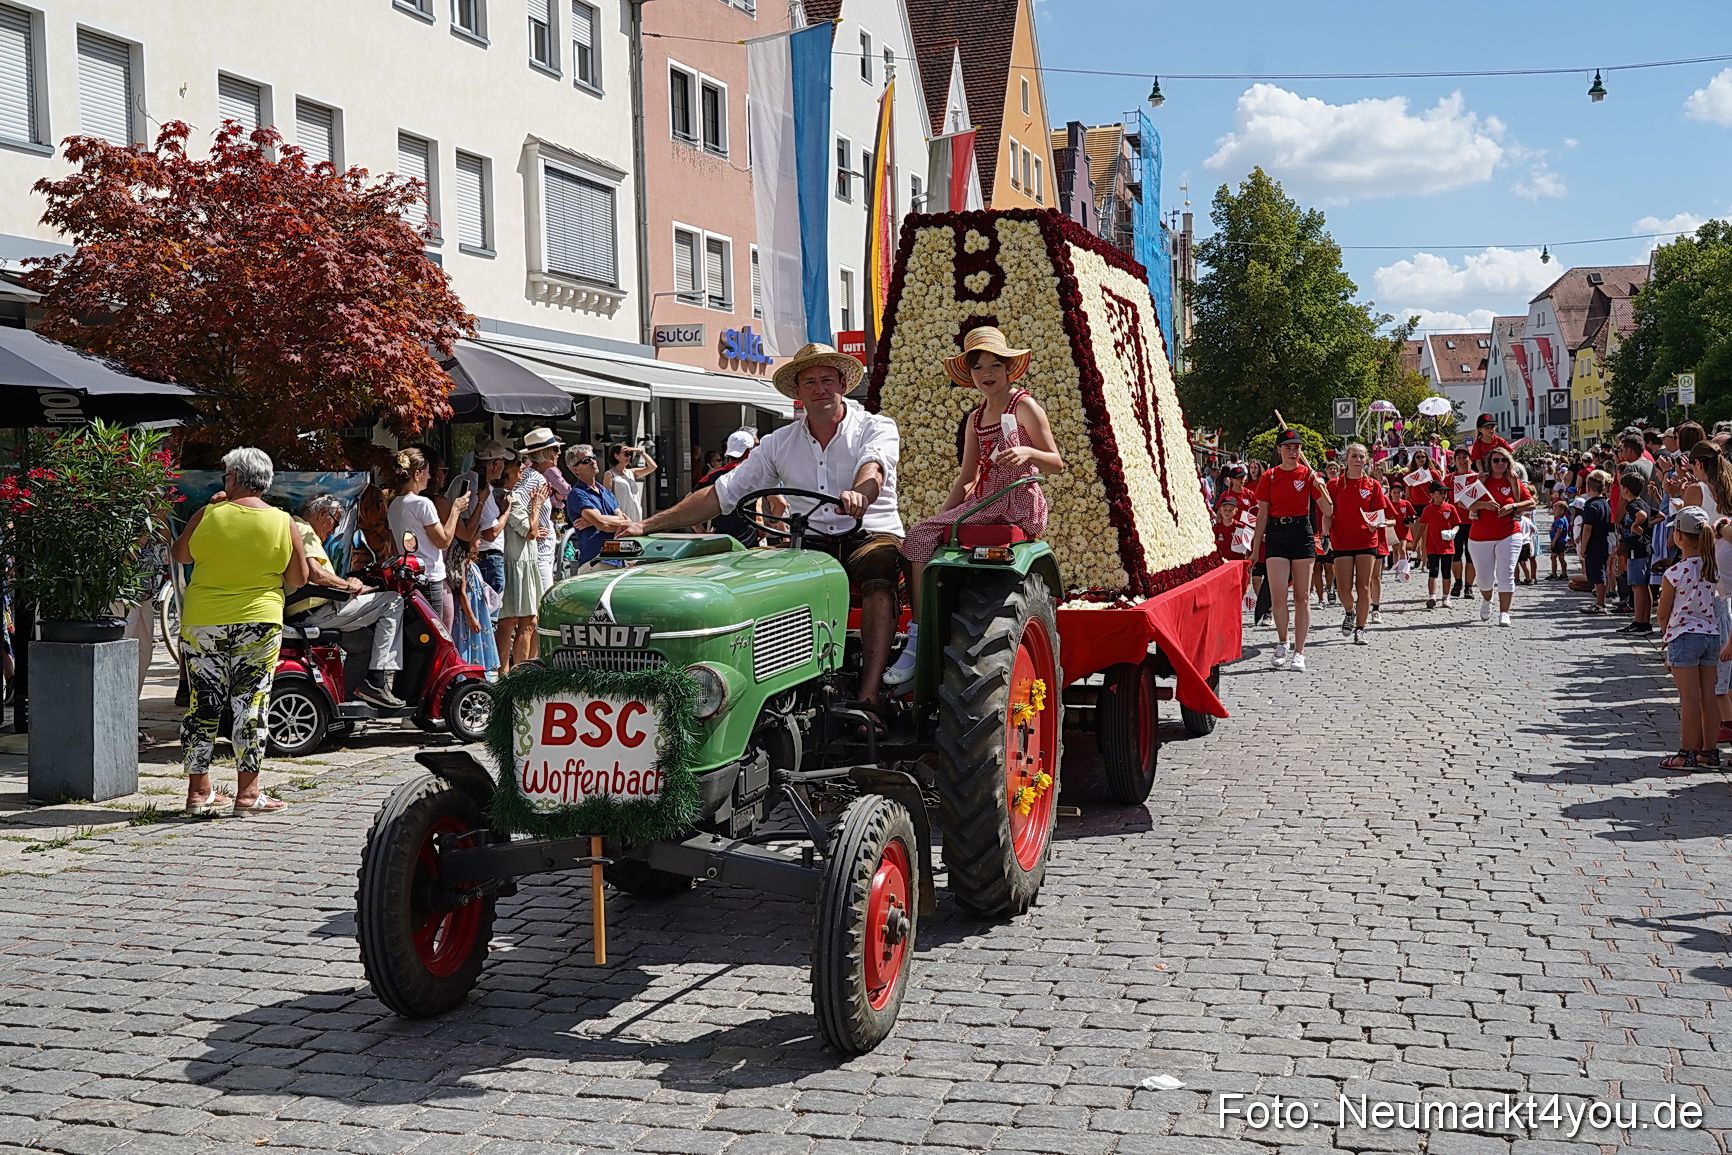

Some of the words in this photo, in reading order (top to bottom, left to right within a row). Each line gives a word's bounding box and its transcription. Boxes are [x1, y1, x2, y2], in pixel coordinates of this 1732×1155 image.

[559, 624, 652, 647] FENDT
[541, 700, 648, 748] BSC
[522, 758, 668, 803] Woffenbach
